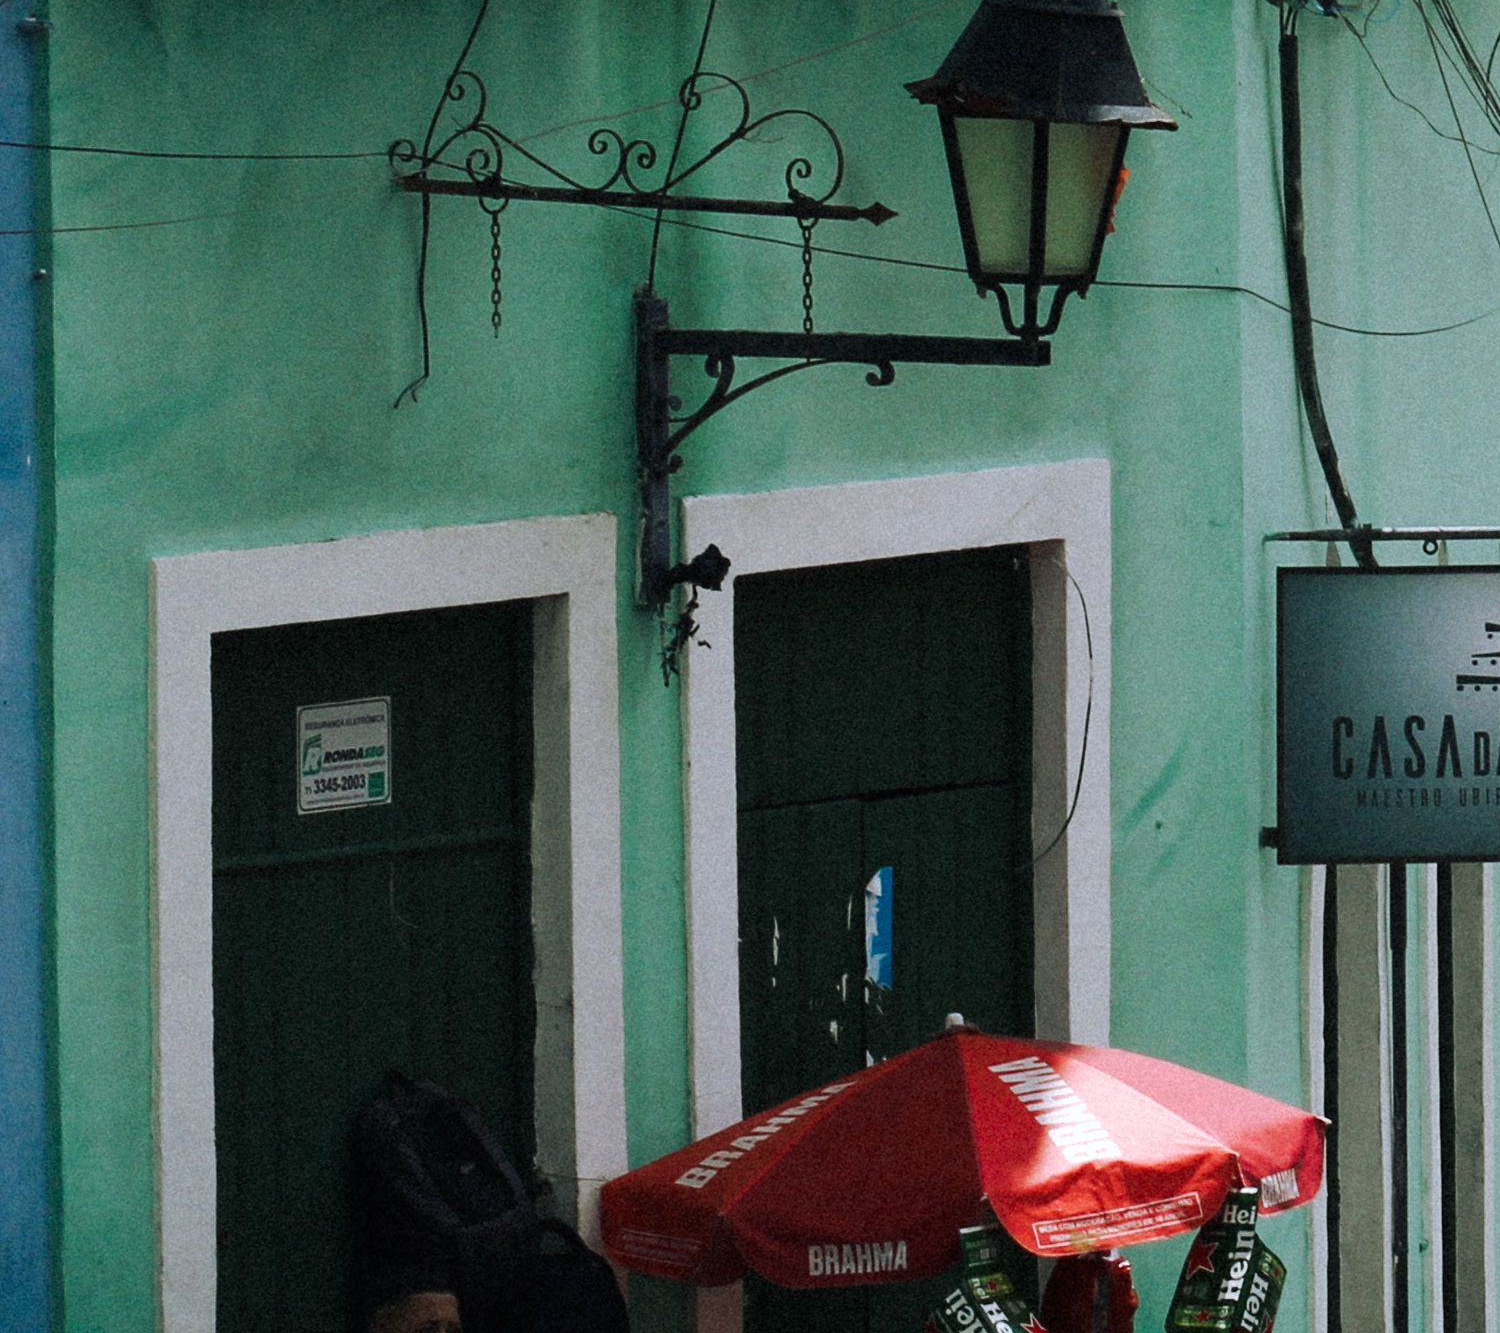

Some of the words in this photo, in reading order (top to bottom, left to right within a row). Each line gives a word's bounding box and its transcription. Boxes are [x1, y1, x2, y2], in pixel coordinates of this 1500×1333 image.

[1332, 715, 1463, 780] CASA
[314, 774, 366, 794] 3345-2003
[1357, 788, 1442, 808] MAESTRO
[675, 1080, 857, 1188] BRAHMA
[988, 1055, 1122, 1163] BRAHMA
[808, 1241, 908, 1276] BRAHMA
